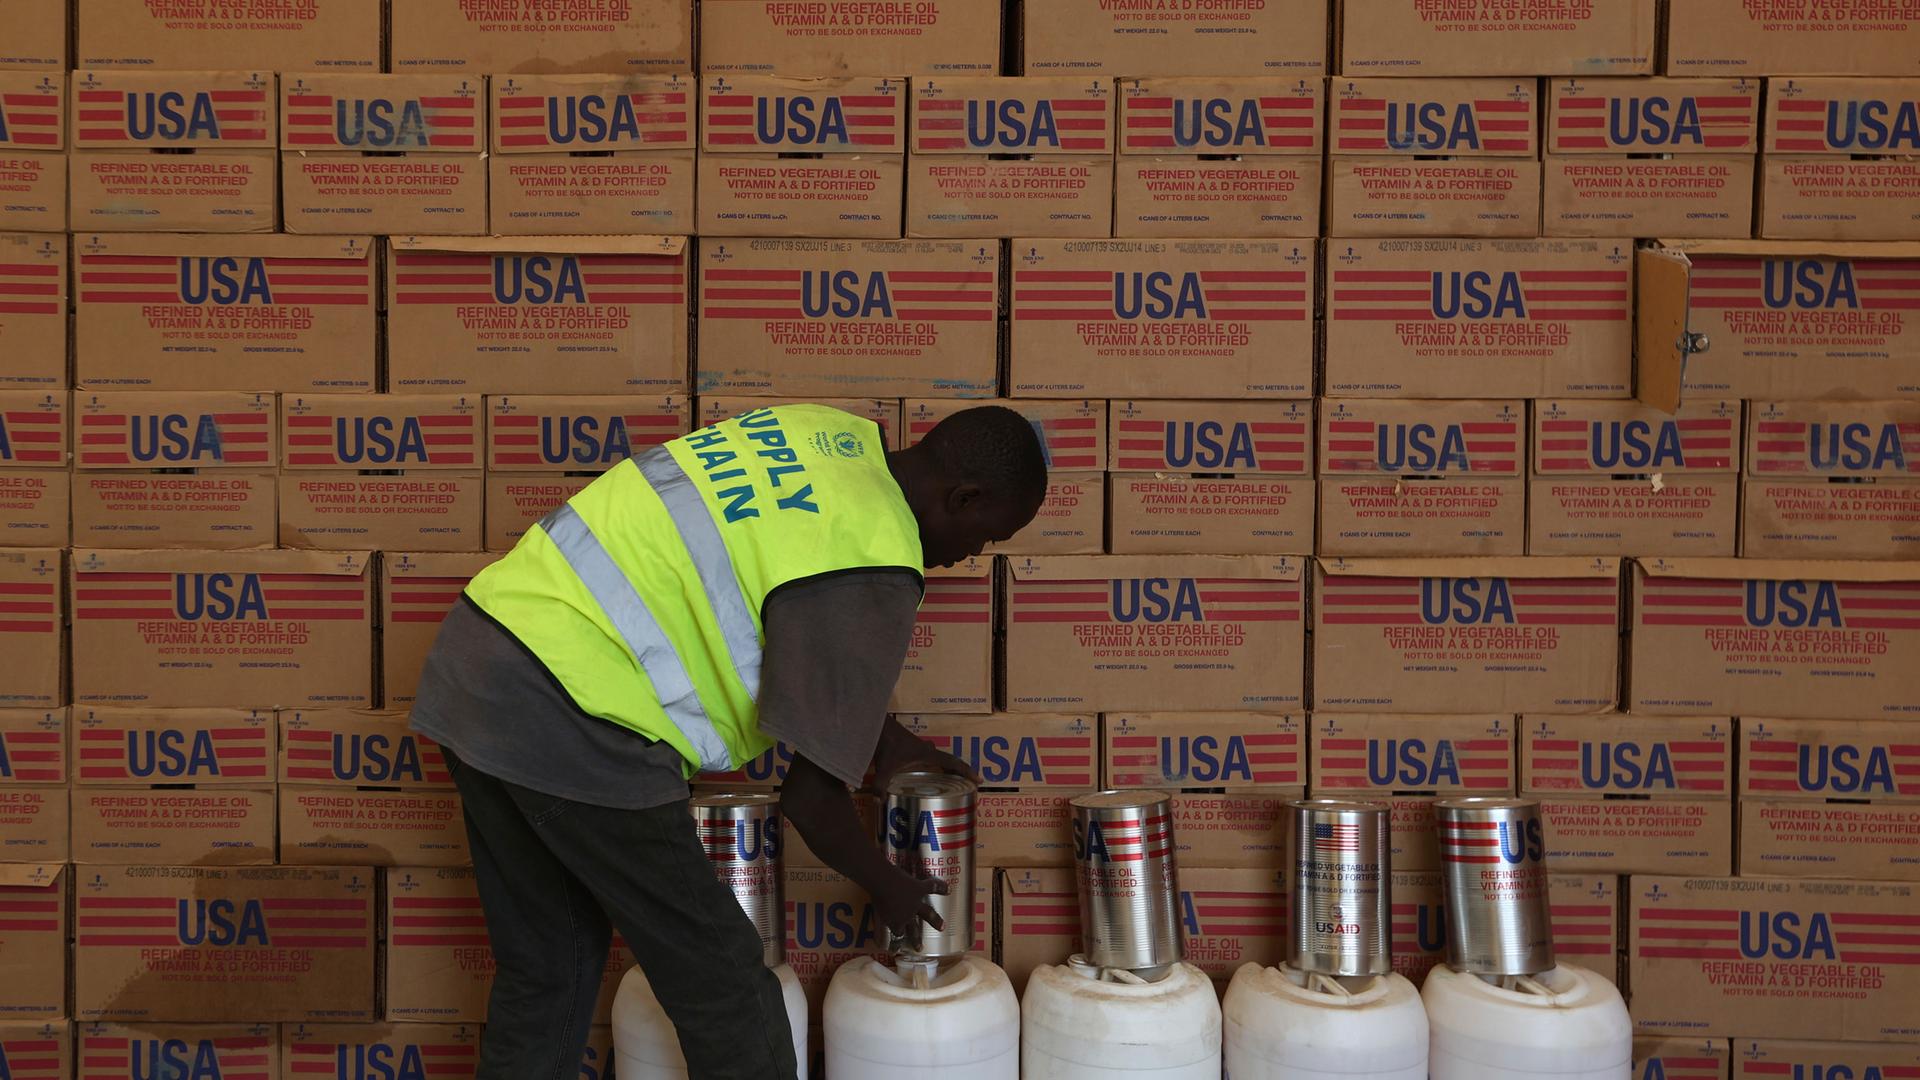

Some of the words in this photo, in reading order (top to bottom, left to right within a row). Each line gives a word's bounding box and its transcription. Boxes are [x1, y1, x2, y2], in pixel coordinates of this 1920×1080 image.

[767, 4, 826, 14] REFINED
[832, 3, 911, 14] VEGETABLE
[916, 3, 939, 14] OIL
[772, 15, 824, 25] VITAMIN
[830, 15, 837, 24] A
[842, 15, 849, 24] &
[855, 15, 863, 24] D
[868, 15, 936, 24] FORTIFIED
[128, 93, 219, 138] USA
[338, 99, 428, 146] USA
[551, 96, 638, 142] USA
[759, 97, 847, 144] USA
[970, 101, 1057, 146] USA
[1176, 100, 1263, 145] USA
[1389, 102, 1477, 148] USA
[1612, 98, 1700, 144] USA
[1828, 101, 1920, 147] USA
[720, 168, 775, 177] REFINED
[780, 168, 854, 179] VEGETABLE
[860, 170, 880, 179] OIL
[728, 179, 775, 188] VITAMIN
[779, 180, 787, 188] A
[802, 181, 810, 189] D
[814, 181, 875, 190] FORTIFIED
[750, 241, 793, 251] 4210007139
[1064, 242, 1107, 252] 4210007139
[1145, 244, 1159, 253] LINE
[1161, 244, 1166, 253] 3
[183, 257, 269, 304] USA
[496, 258, 583, 303] USA
[804, 272, 891, 316] USA
[1117, 272, 1204, 318] USA
[1434, 272, 1523, 317] USA
[1766, 261, 1856, 307] USA
[143, 306, 202, 317] REFINED
[208, 307, 286, 318] VEGETABLE
[292, 308, 313, 318] OIL
[1078, 324, 1138, 334] REFINED
[1144, 324, 1224, 334] VEGETABLE
[1229, 324, 1251, 334] OIL
[1396, 324, 1456, 334] REFINED
[1462, 324, 1542, 334] VEGETABLE
[1548, 324, 1571, 334] OIL
[1724, 311, 1786, 322] REFINED
[1792, 312, 1874, 323] VEGETABLE
[1880, 313, 1903, 324] OIL
[1084, 335, 1136, 345] VITAMIN
[1141, 336, 1149, 345] A
[1154, 336, 1161, 345] &
[1167, 336, 1175, 345] D
[1180, 335, 1248, 345] FORTIFIED
[133, 416, 220, 460] USA
[338, 417, 426, 462] USA
[543, 416, 630, 463] USA
[1167, 422, 1254, 467] USA
[1378, 425, 1466, 470] USA
[1593, 422, 1682, 466] USA
[1811, 424, 1904, 468] USA
[91, 480, 147, 488] REFINED
[151, 480, 226, 489] VEGETABLE
[232, 480, 252, 489] OIL
[686, 425, 760, 524] HAIN
[1131, 484, 1187, 492] REFINED
[1193, 484, 1266, 493] VEGETABLE
[1271, 485, 1290, 493] OIL
[178, 574, 265, 619] USA
[1114, 578, 1200, 621] USA
[1424, 579, 1512, 623] USA
[1748, 581, 1840, 626] USA
[138, 622, 196, 633] REFINED
[202, 622, 282, 633] VEGETABLE
[288, 623, 310, 633] OIL
[1074, 625, 1132, 635] REFINED
[1138, 625, 1219, 635] VEGETABLE
[1224, 625, 1246, 635] OIL
[130, 732, 217, 776] USA
[334, 735, 421, 781] USA
[953, 736, 1041, 781] USA
[1163, 736, 1250, 780] USA
[1370, 740, 1459, 785] USA
[1583, 743, 1674, 788] USA
[1800, 746, 1892, 792] USA
[92, 798, 148, 806] REFINED
[152, 798, 226, 807] VEGETABLE
[232, 798, 252, 806] OIL
[1543, 806, 1600, 814] REFINED
[1605, 806, 1680, 815] VEGETABLE
[1686, 807, 1707, 816] OIL
[946, 856, 960, 865] OIL
[1119, 868, 1136, 877] OIL
[1481, 870, 1525, 880] REFINED
[1481, 882, 1523, 891] VITAMIN
[180, 899, 267, 944] USA
[1315, 922, 1360, 934] USAID
[1742, 912, 1833, 959] USA
[1703, 962, 1764, 973] REFINED
[1770, 964, 1854, 976] VEGETABLE
[1861, 966, 1884, 978] OIL
[133, 1040, 220, 1080] USA
[338, 1044, 424, 1080] USA
